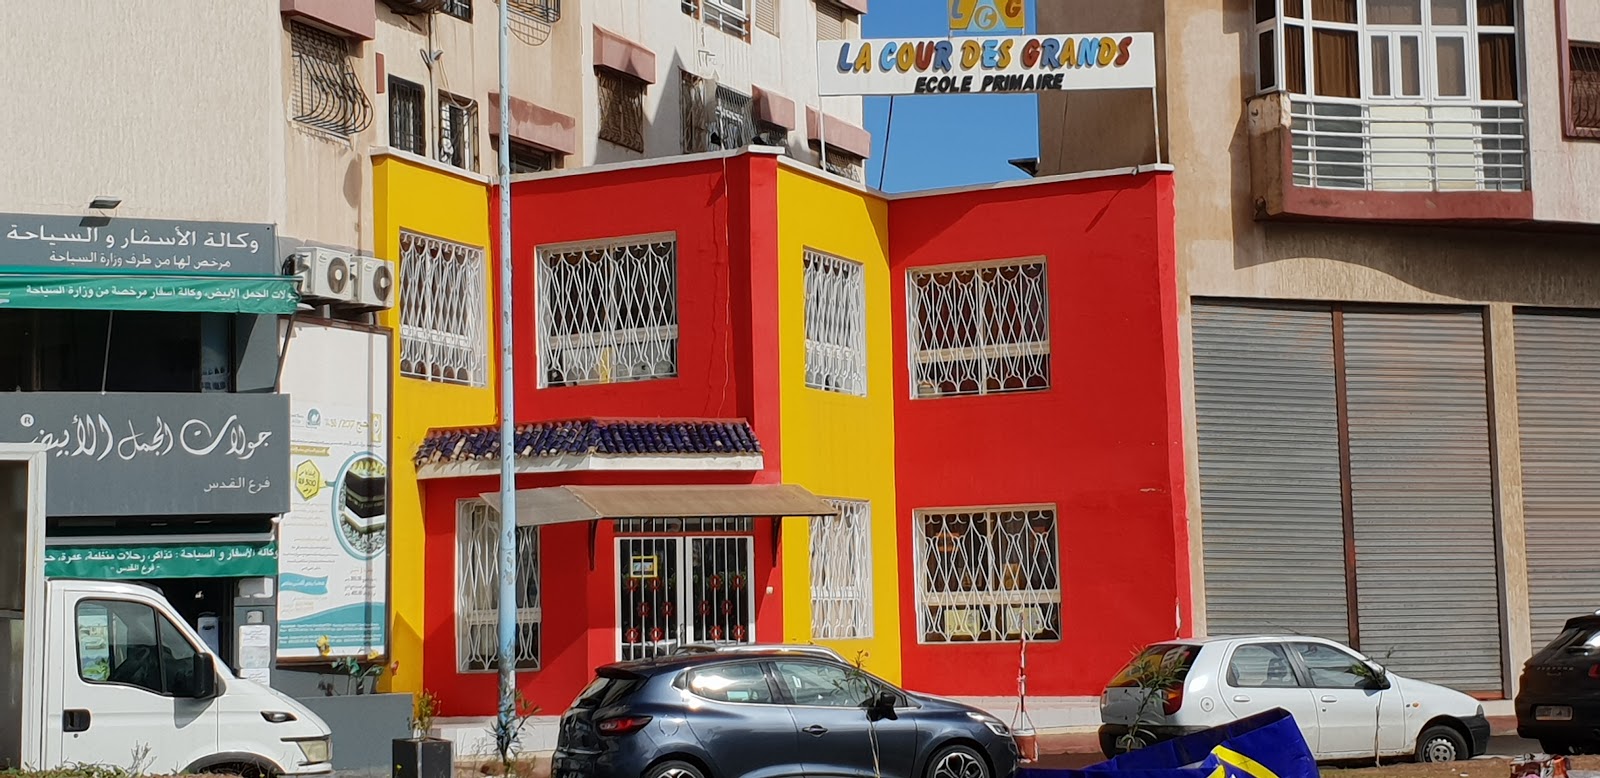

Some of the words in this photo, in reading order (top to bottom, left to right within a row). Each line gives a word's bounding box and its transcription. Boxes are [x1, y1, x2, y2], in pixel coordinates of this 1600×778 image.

[837, 42, 871, 72] LA
[879, 40, 953, 72] COUR
[961, 38, 1014, 69] DES
[1021, 36, 1133, 69] GRANDS
[914, 75, 974, 94] ECOLE
[981, 73, 1066, 92] PRIMAIRE
[6, 223, 99, 248] السياحة
[105, 236, 116, 248] و
[120, 225, 197, 250] الأسفار
[203, 231, 260, 254] وكالة
[49, 250, 98, 265] السياحة
[100, 252, 123, 267] وزارة
[125, 252, 152, 268] طرف
[154, 256, 171, 268] من
[173, 254, 191, 269] لها
[195, 256, 232, 271] مرخص
[26, 284, 66, 298] السياحة
[67, 285, 94, 298] وزارة
[96, 286, 110, 297] من
[111, 286, 148, 299] مرخصة
[178, 286, 203, 300] وكالة
[242, 289, 269, 301] الجمل
[117, 415, 175, 461] الجمل
[180, 414, 273, 461] جولات
[203, 477, 246, 493] القدس
[248, 478, 271, 493] فرع
[117, 550, 146, 562] رحلات
[180, 548, 215, 560] السياحة
[218, 551, 225, 561] و
[140, 564, 156, 575] فرع
